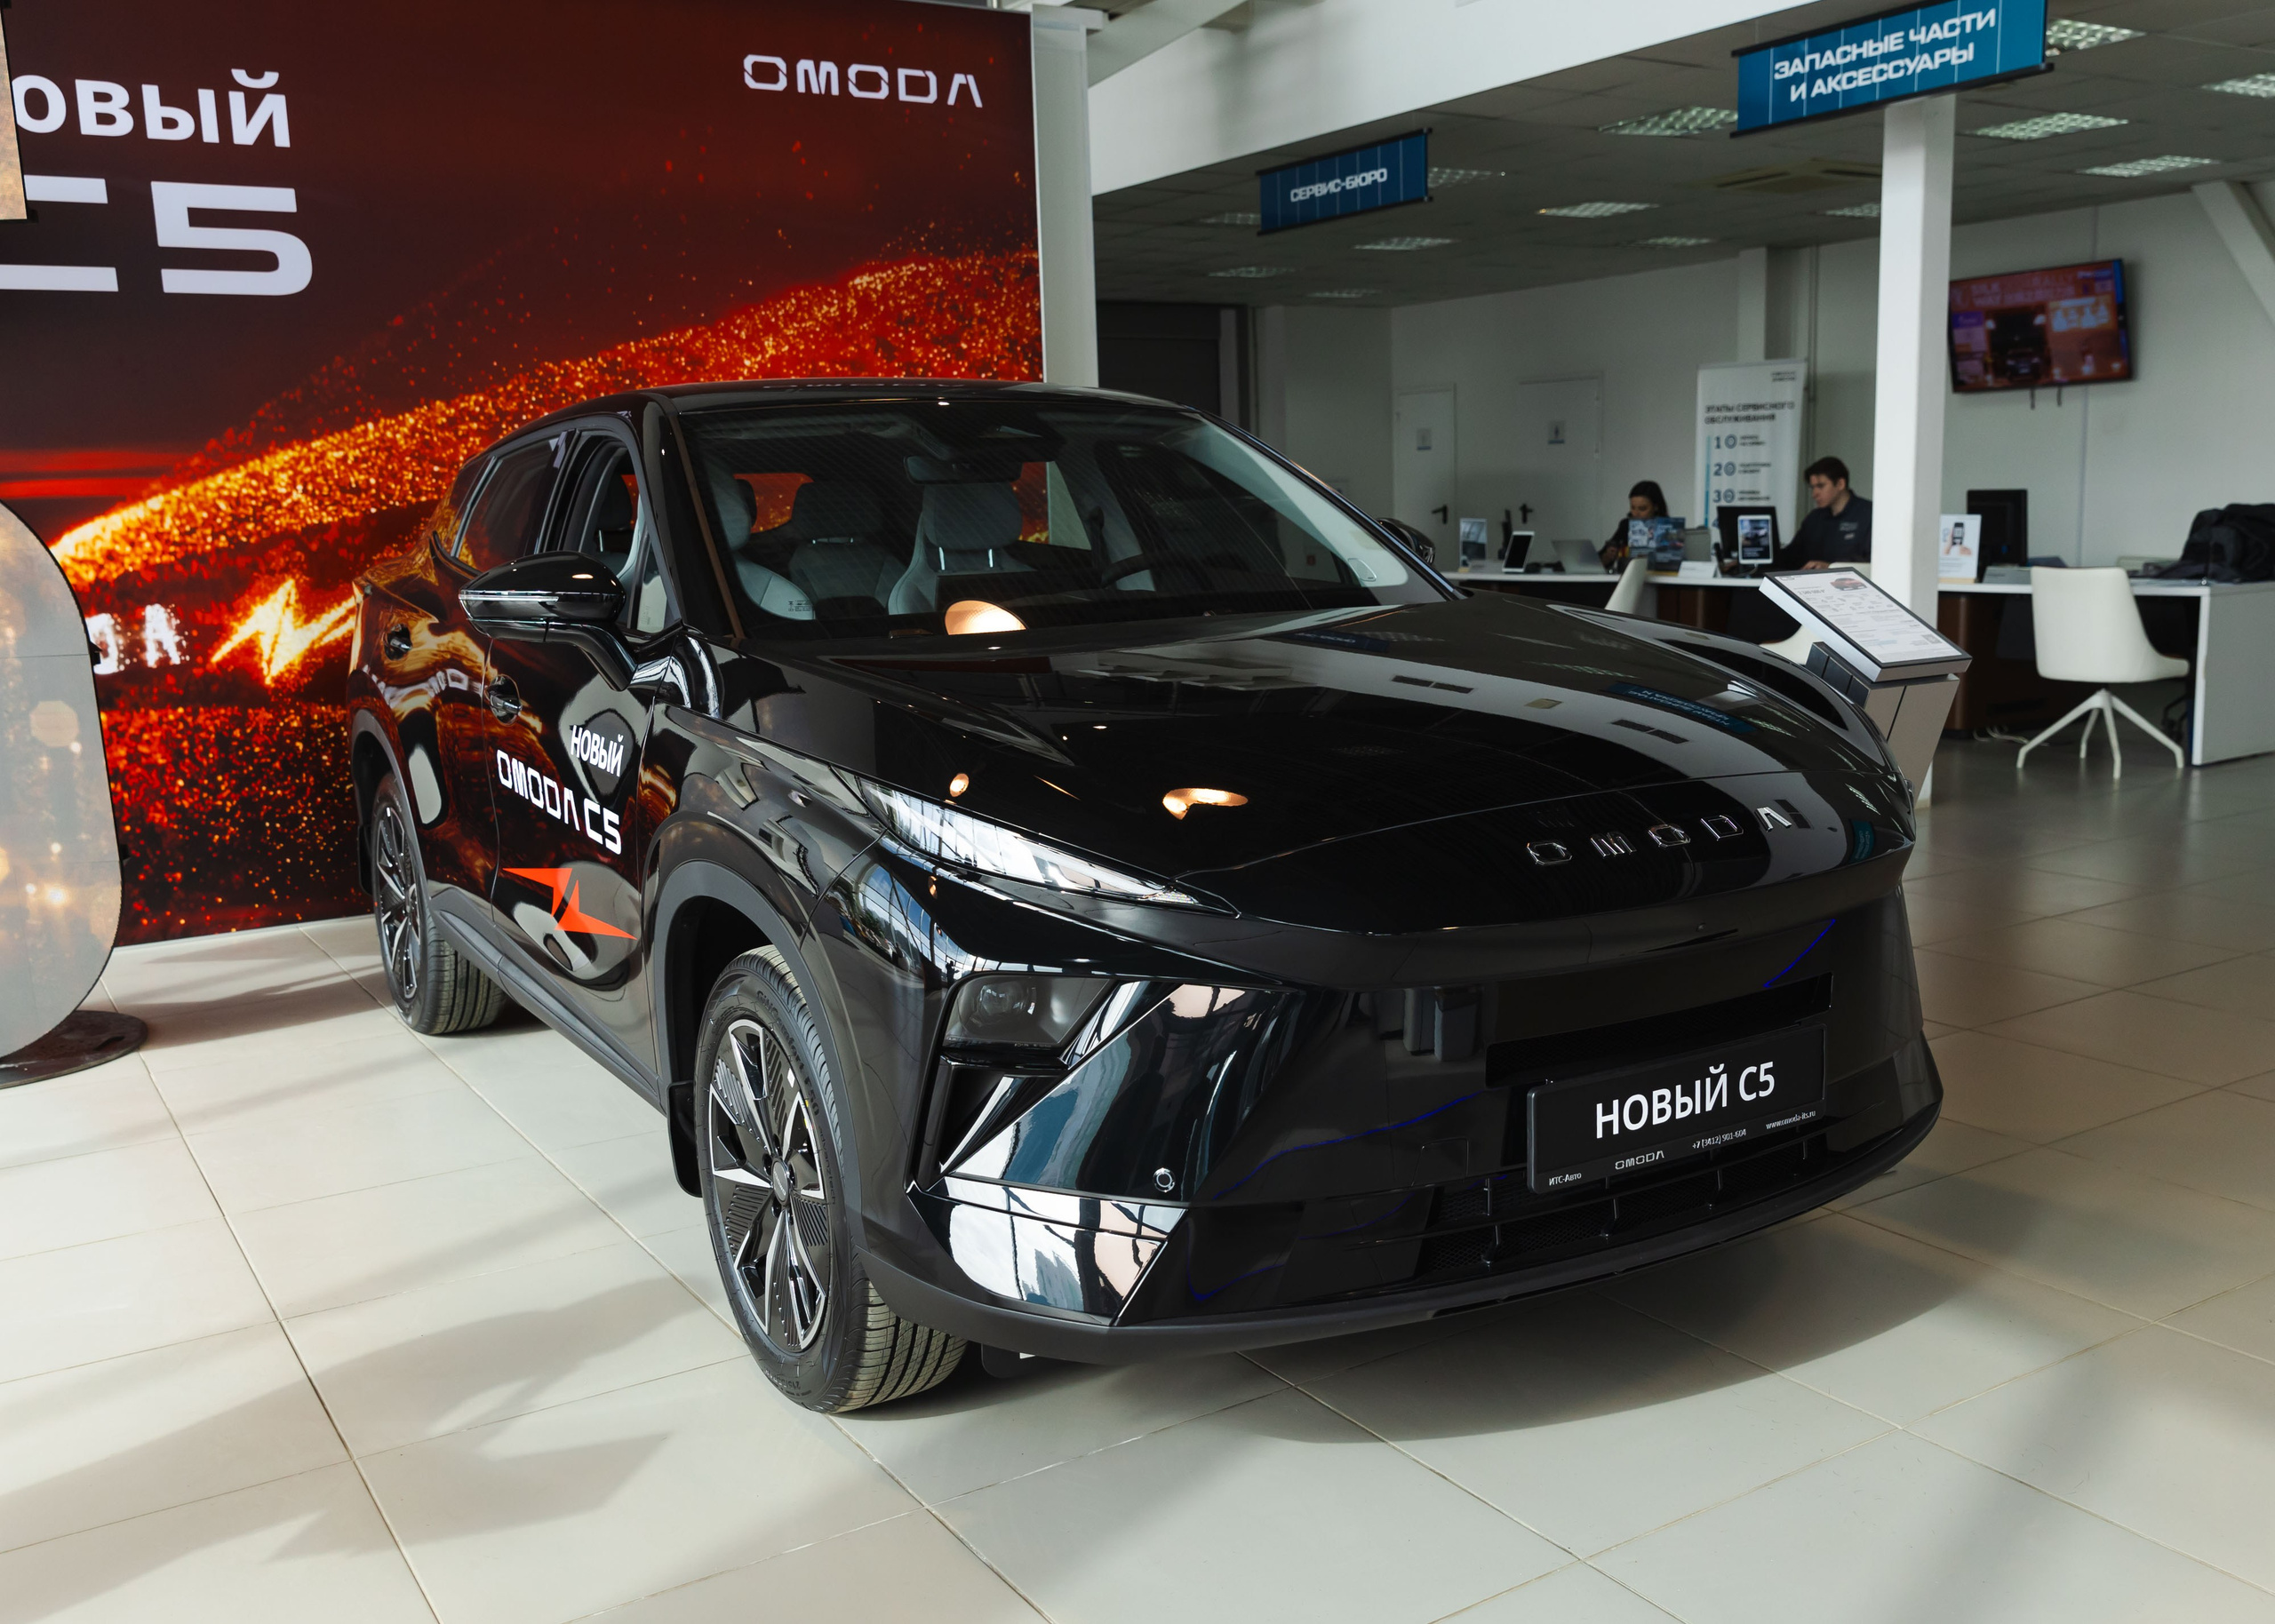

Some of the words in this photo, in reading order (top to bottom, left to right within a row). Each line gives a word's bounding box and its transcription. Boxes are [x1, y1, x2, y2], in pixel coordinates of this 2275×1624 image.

[1773, 31, 1904, 80] ЗАПАСНЫЕ
[1908, 8, 1996, 43] ЧАСТИ
[743, 53, 983, 108] OMODA
[1790, 83, 1807, 103] И
[1809, 43, 1975, 99] АКСЕССУАРЫ
[1289, 168, 1388, 203] СЕРВИС-БЮРО
[1735, 401, 1795, 412] СЕРВИСНОГО
[1712, 463, 1722, 477] 2
[1714, 435, 1721, 450] 1
[1712, 490, 1722, 504] 3
[570, 724, 624, 777] НОВЫЙ
[497, 749, 580, 832] OMODA
[583, 798, 622, 856] C5
[1526, 806, 1793, 866] OMODA
[1595, 1063, 1728, 1139] НОВЫЙ
[1738, 1061, 1776, 1102] C5
[1549, 1173, 1582, 1186] ИТС-Авто
[1615, 1150, 1664, 1171] OMODA
[1701, 1134, 1721, 1149] (3412)
[1721, 1128, 1747, 1142] 901-604
[1766, 1111, 1816, 1129] www.omoda-its.ru
